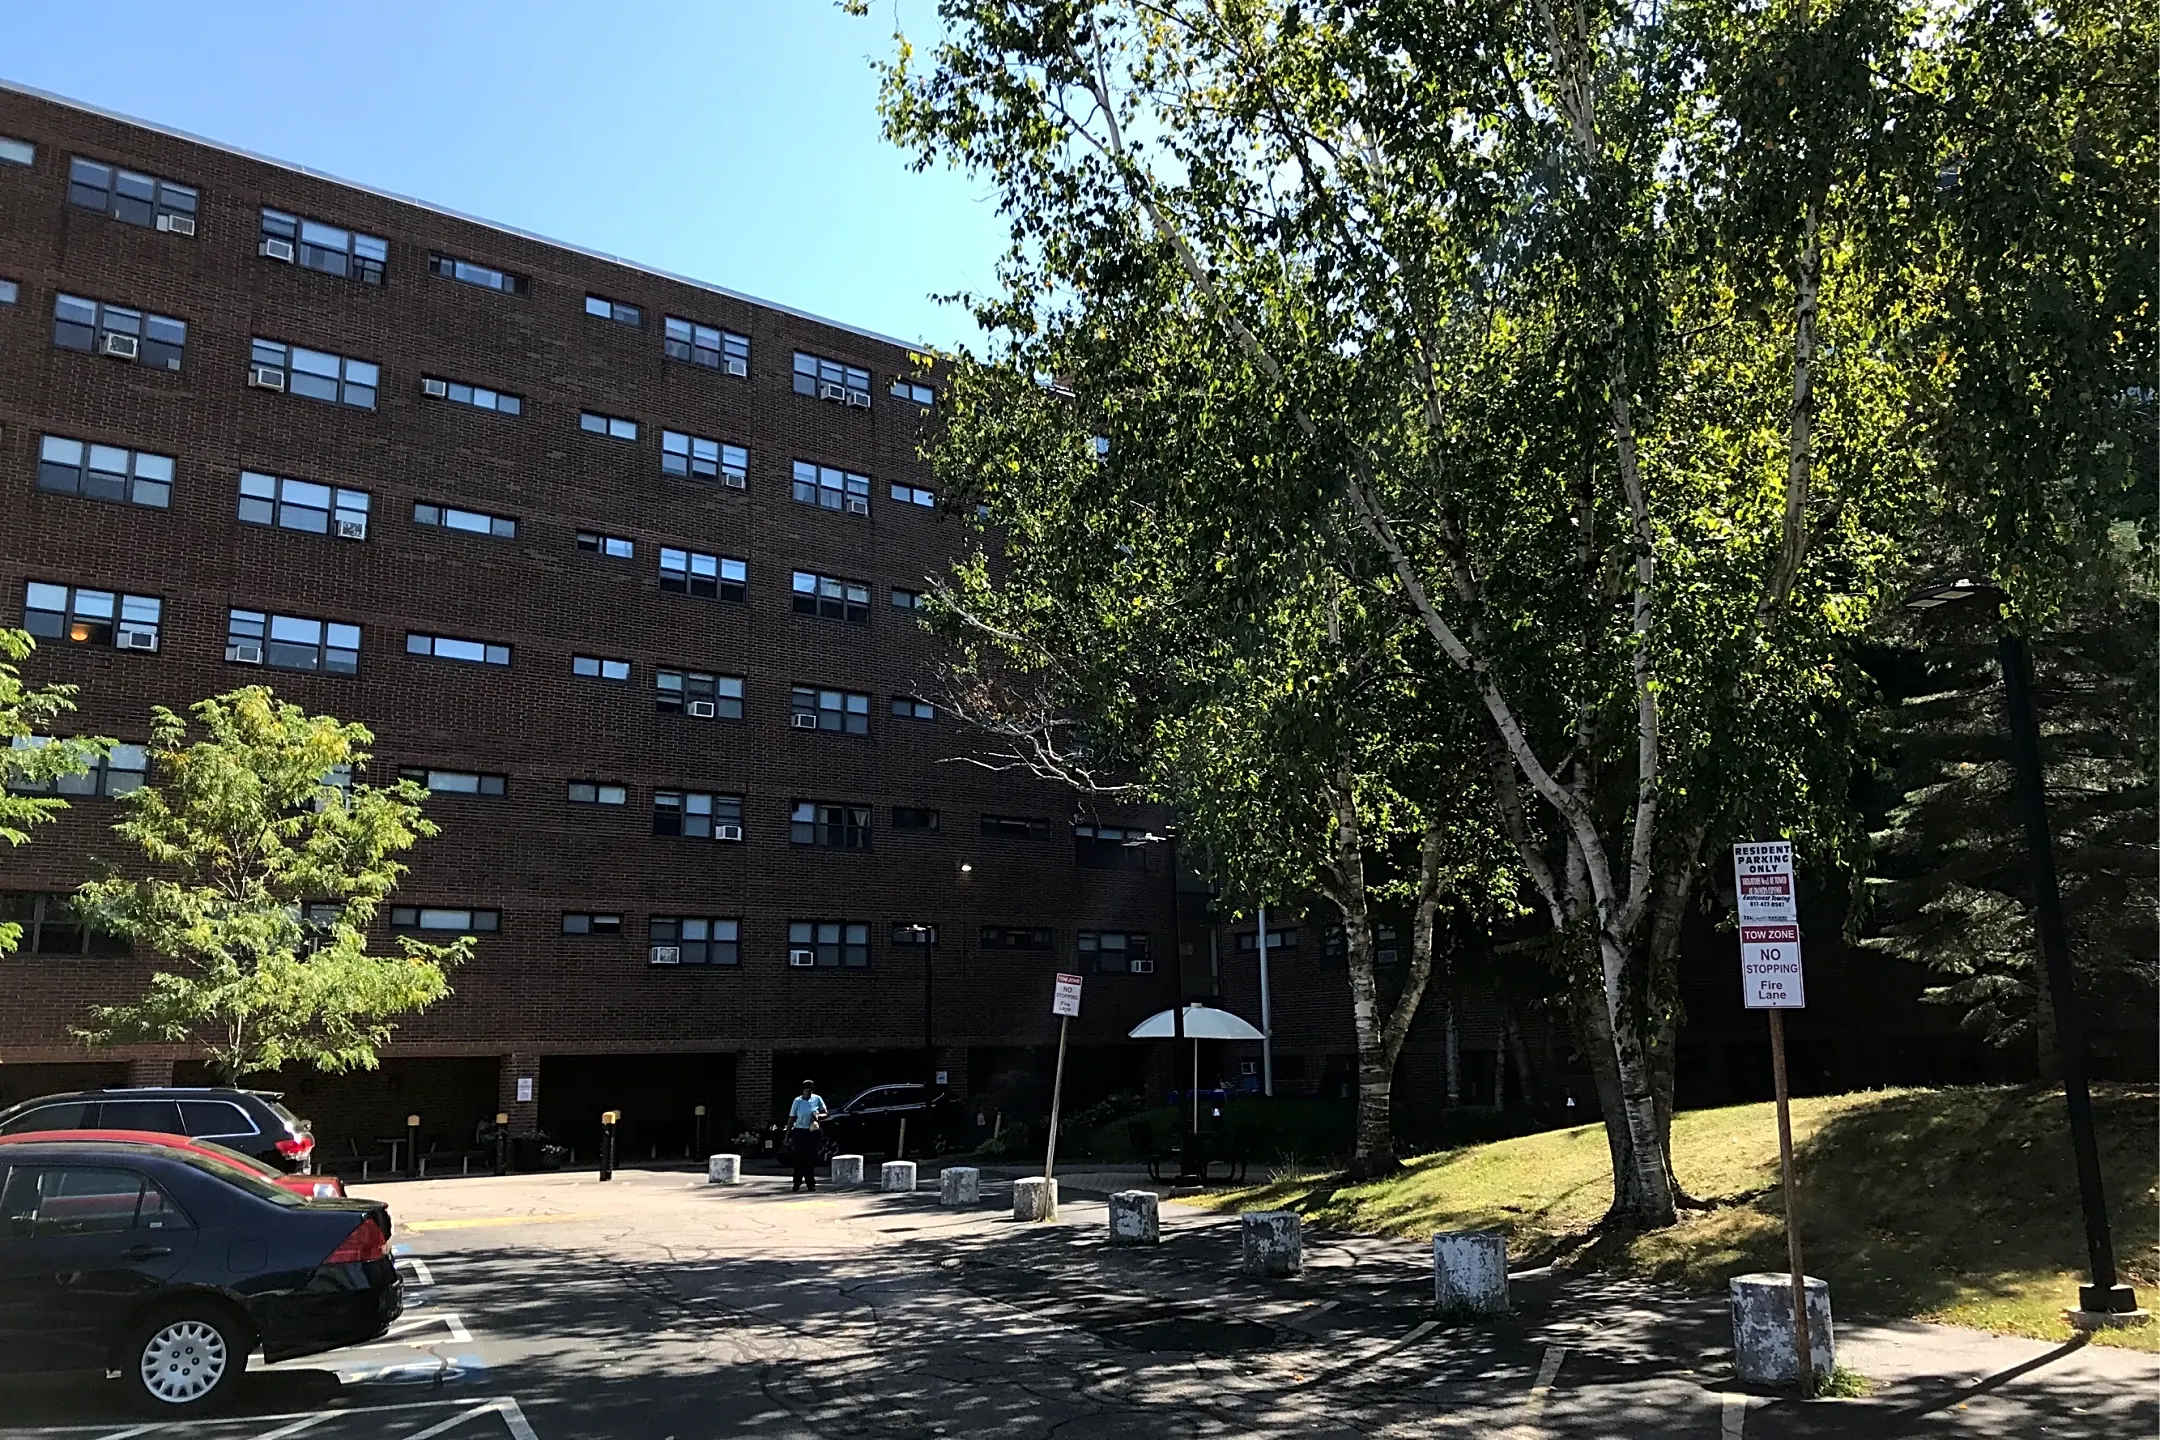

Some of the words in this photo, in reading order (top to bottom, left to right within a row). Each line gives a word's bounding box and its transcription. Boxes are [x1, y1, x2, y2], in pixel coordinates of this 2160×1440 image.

[1735, 846, 1790, 855] RESIDENT
[1738, 855, 1788, 864] PARKING
[1749, 865, 1778, 873] ONLY
[1745, 931, 1766, 939] TOW
[1768, 930, 1795, 939] ZONE
[1761, 949, 1781, 960] NO
[1747, 964, 1798, 974] STOPPING
[1761, 981, 1782, 990] Fire
[1759, 991, 1786, 999] Lane
